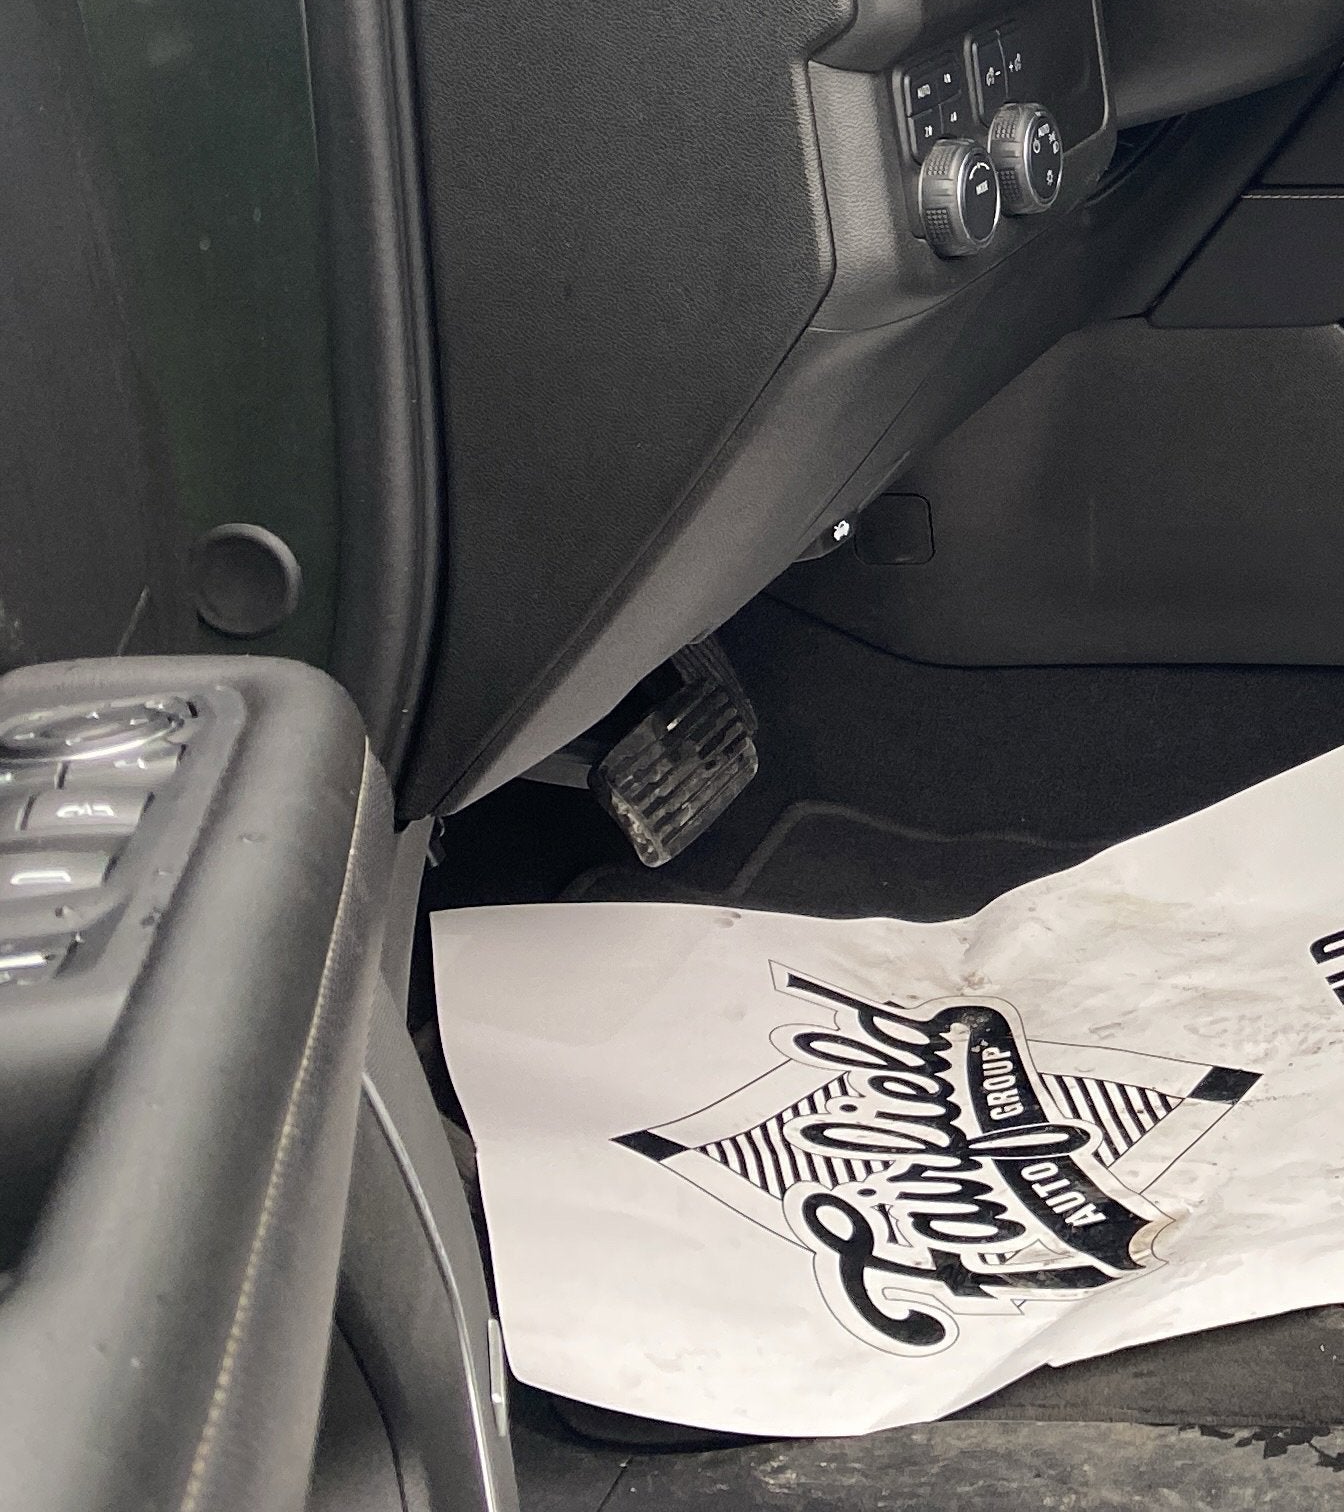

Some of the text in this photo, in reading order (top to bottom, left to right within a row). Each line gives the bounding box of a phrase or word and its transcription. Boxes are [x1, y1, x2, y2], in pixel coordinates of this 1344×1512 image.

[786, 973, 1124, 1346] Fairfield
[981, 1045, 1107, 1230] AUTO GROUP
